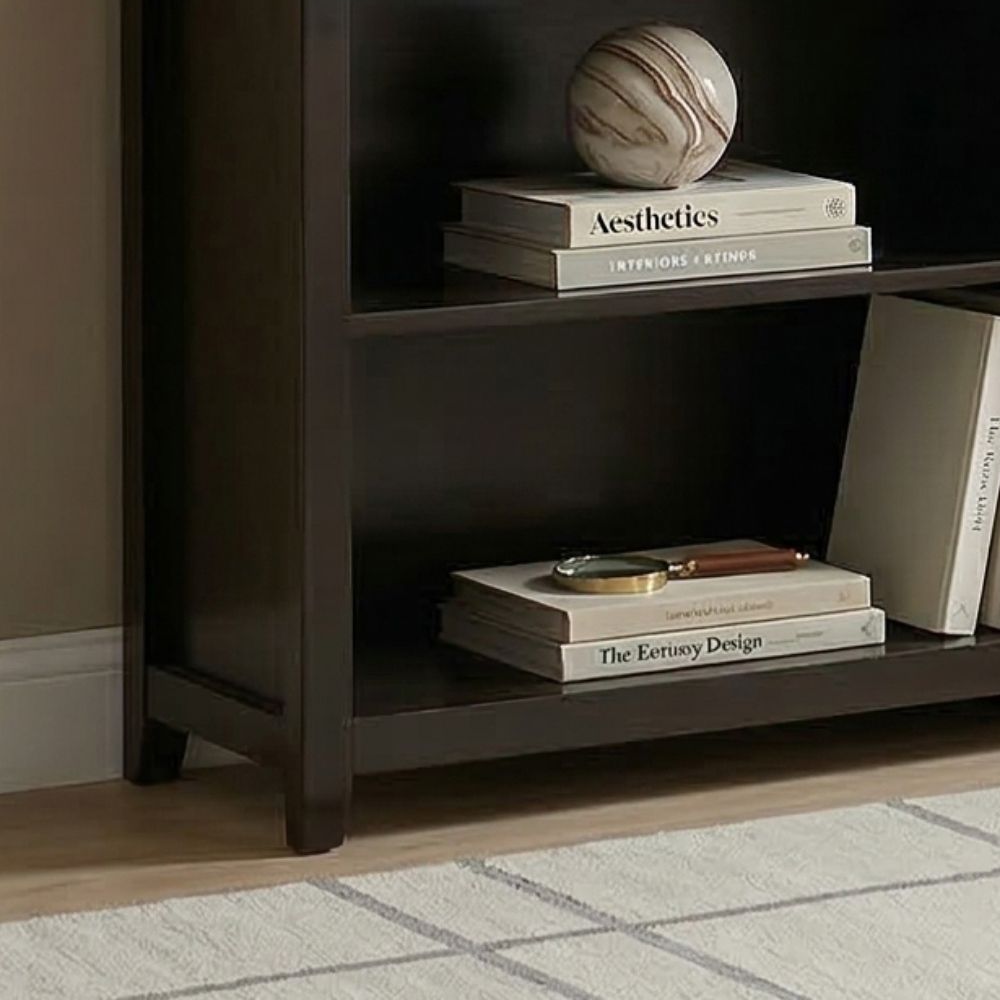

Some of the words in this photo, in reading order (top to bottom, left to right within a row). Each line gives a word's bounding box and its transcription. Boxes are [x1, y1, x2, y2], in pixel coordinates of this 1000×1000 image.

[589, 203, 720, 235] Aesthetics
[599, 646, 632, 665] The
[706, 633, 763, 655] Design
